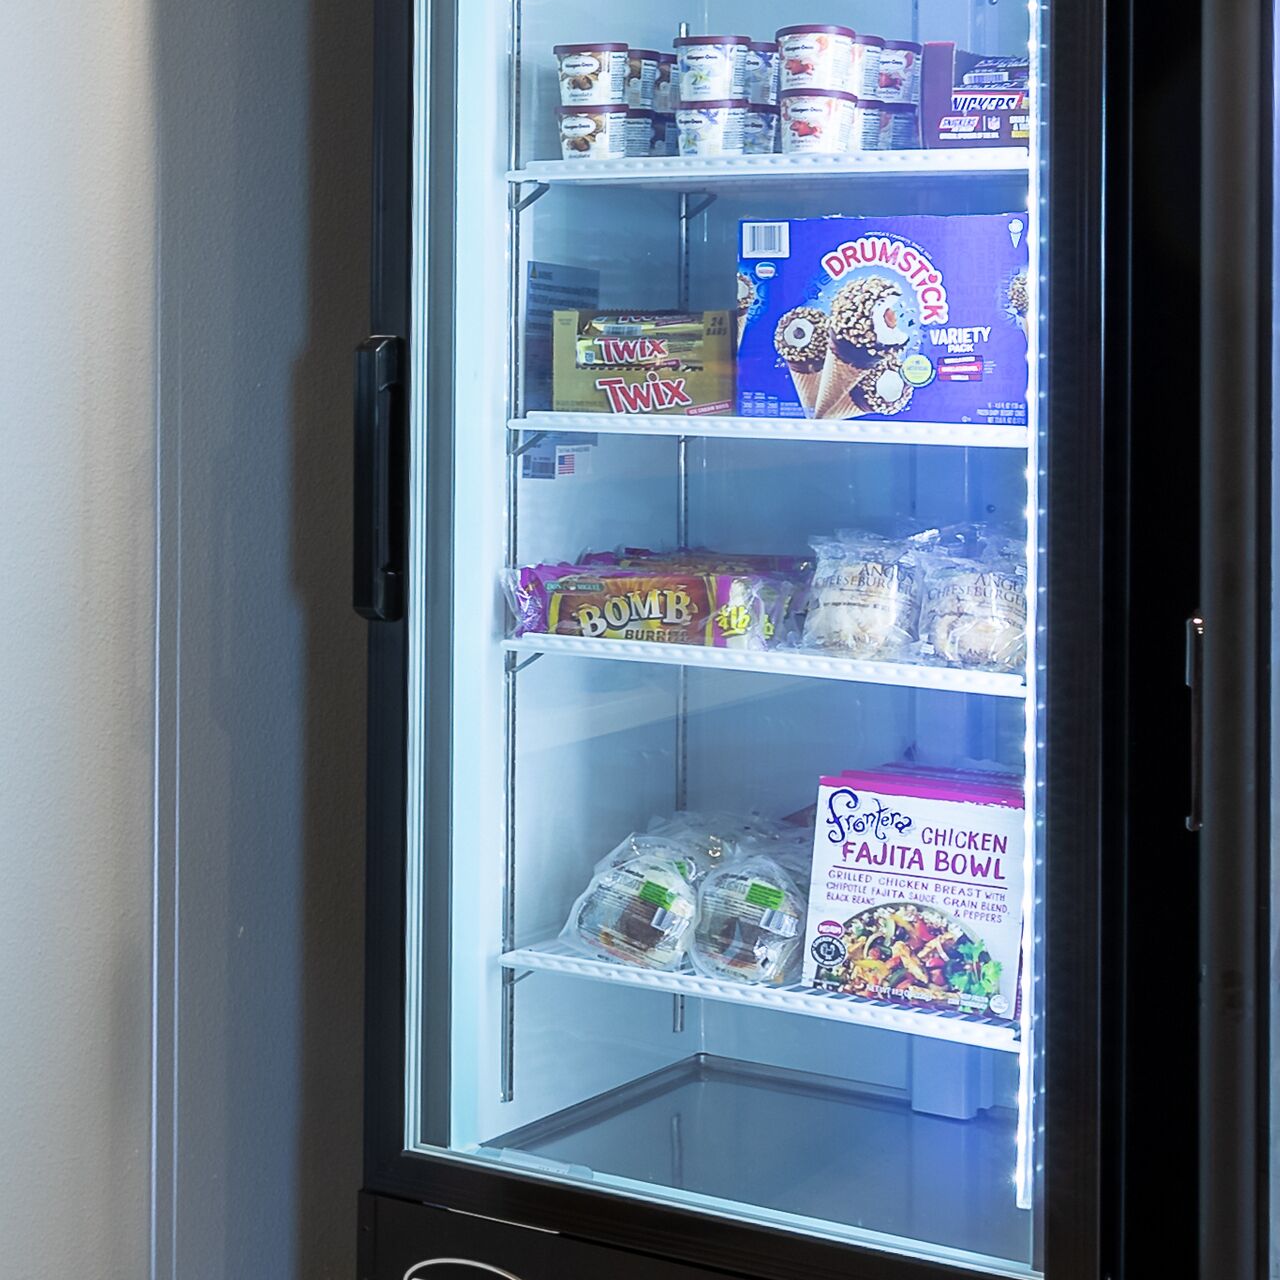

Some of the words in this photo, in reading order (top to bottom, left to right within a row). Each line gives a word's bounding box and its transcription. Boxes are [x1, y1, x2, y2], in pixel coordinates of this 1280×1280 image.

[929, 326, 991, 346] VARIETY
[947, 343, 974, 353] PACK
[974, 572, 1027, 591] ANGU
[577, 587, 695, 637] BOMB
[921, 826, 1008, 855] CHICKEN
[842, 841, 924, 871] FAJITA
[934, 850, 1006, 880] BOWL
[826, 881, 868, 895] CHIPOTLE
[871, 887, 905, 900] FAJITA
[943, 896, 978, 911] GRAIN
[828, 869, 873, 885] GRILLED
[878, 876, 930, 892] CHICKEN
[934, 883, 982, 899] BREAST
[984, 891, 1006, 902] WITH
[826, 891, 850, 903] BLACK
[851, 895, 876, 907] BEANS
[963, 910, 1003, 924] PEPPERS
